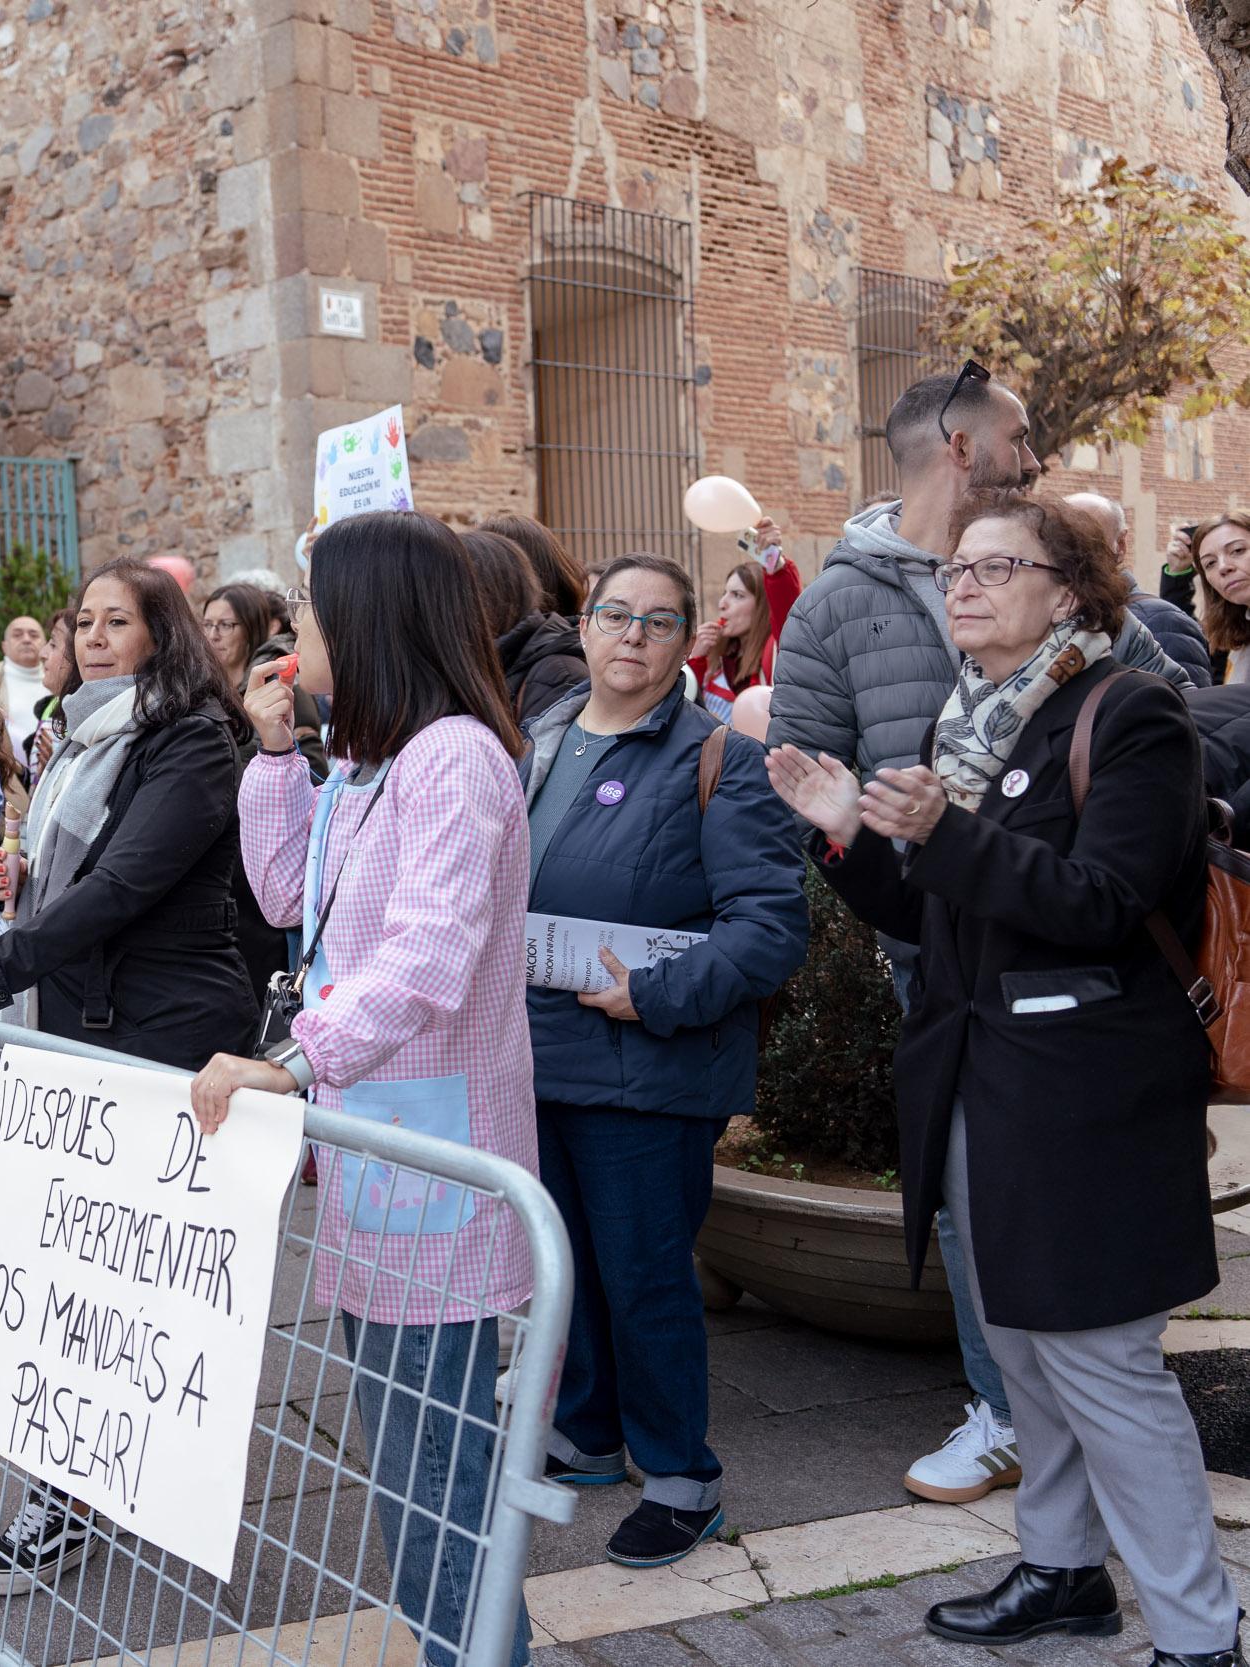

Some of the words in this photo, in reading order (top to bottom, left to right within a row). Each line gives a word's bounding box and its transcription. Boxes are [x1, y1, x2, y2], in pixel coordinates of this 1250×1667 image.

[348, 467, 374, 481] NUESTRA
[353, 498, 362, 509] ES
[546, 921, 557, 953] INFANTIL
[157, 1111, 211, 1193] DE
[177, 1351, 208, 1427] A
[9, 1361, 152, 1514] PASEAR!
